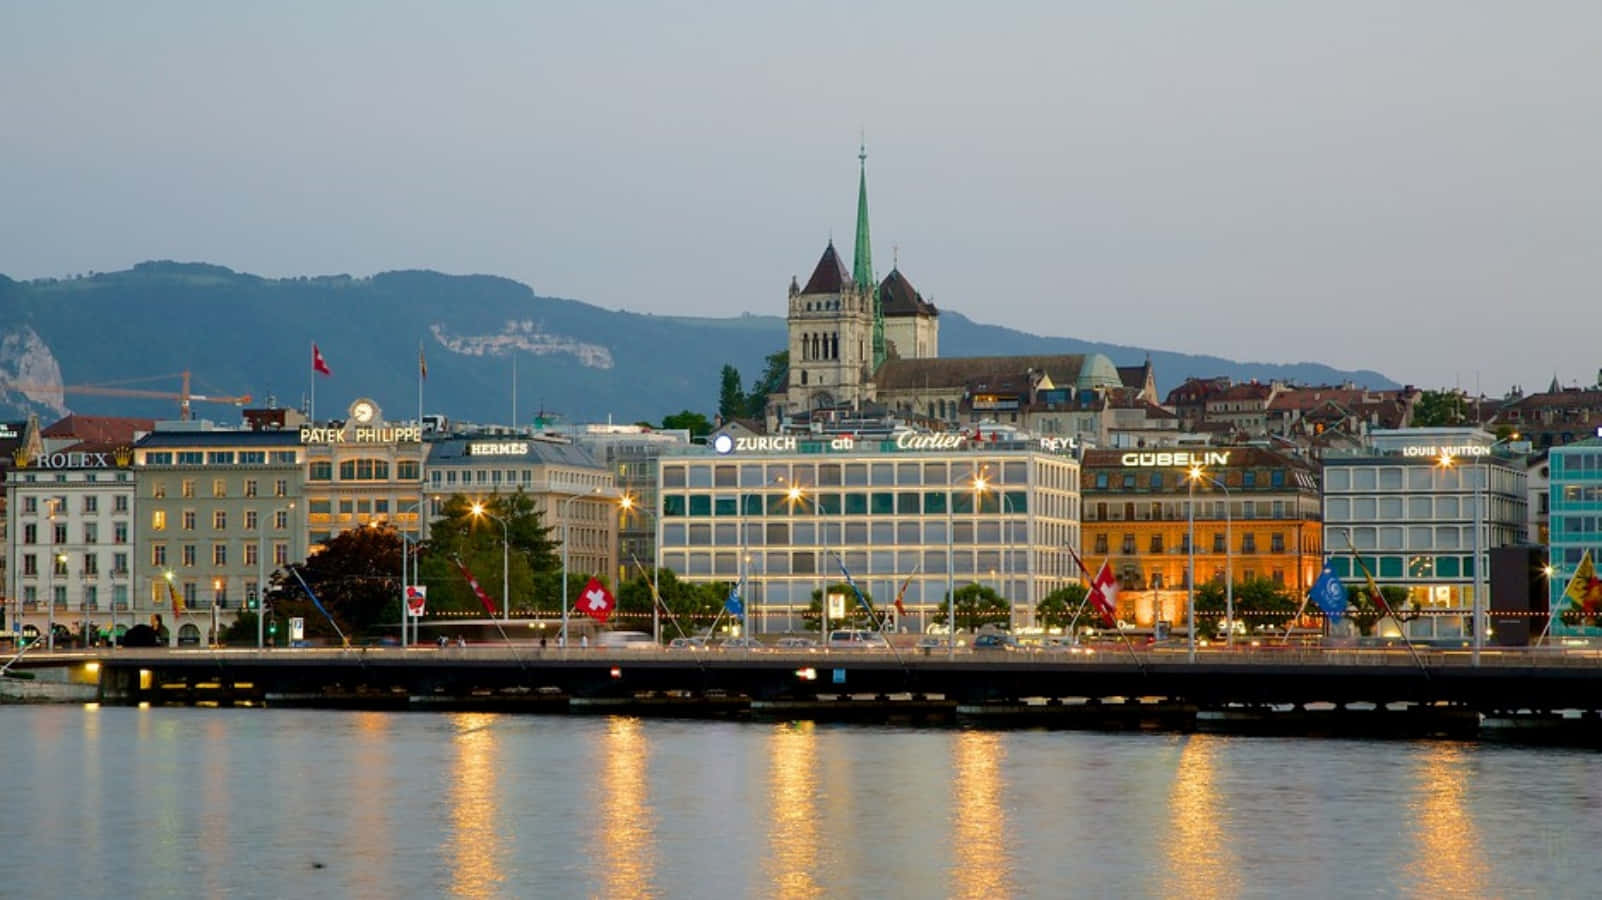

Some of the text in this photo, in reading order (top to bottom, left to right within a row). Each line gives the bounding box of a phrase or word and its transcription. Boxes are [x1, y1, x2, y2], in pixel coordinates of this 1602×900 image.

[300, 427, 422, 442] PATEK PHILIPPE
[897, 430, 966, 448] Cartier
[735, 438, 796, 450] ZURICH
[1402, 446, 1490, 456] LOUIS VUITTON
[36, 452, 108, 468] ROLEX
